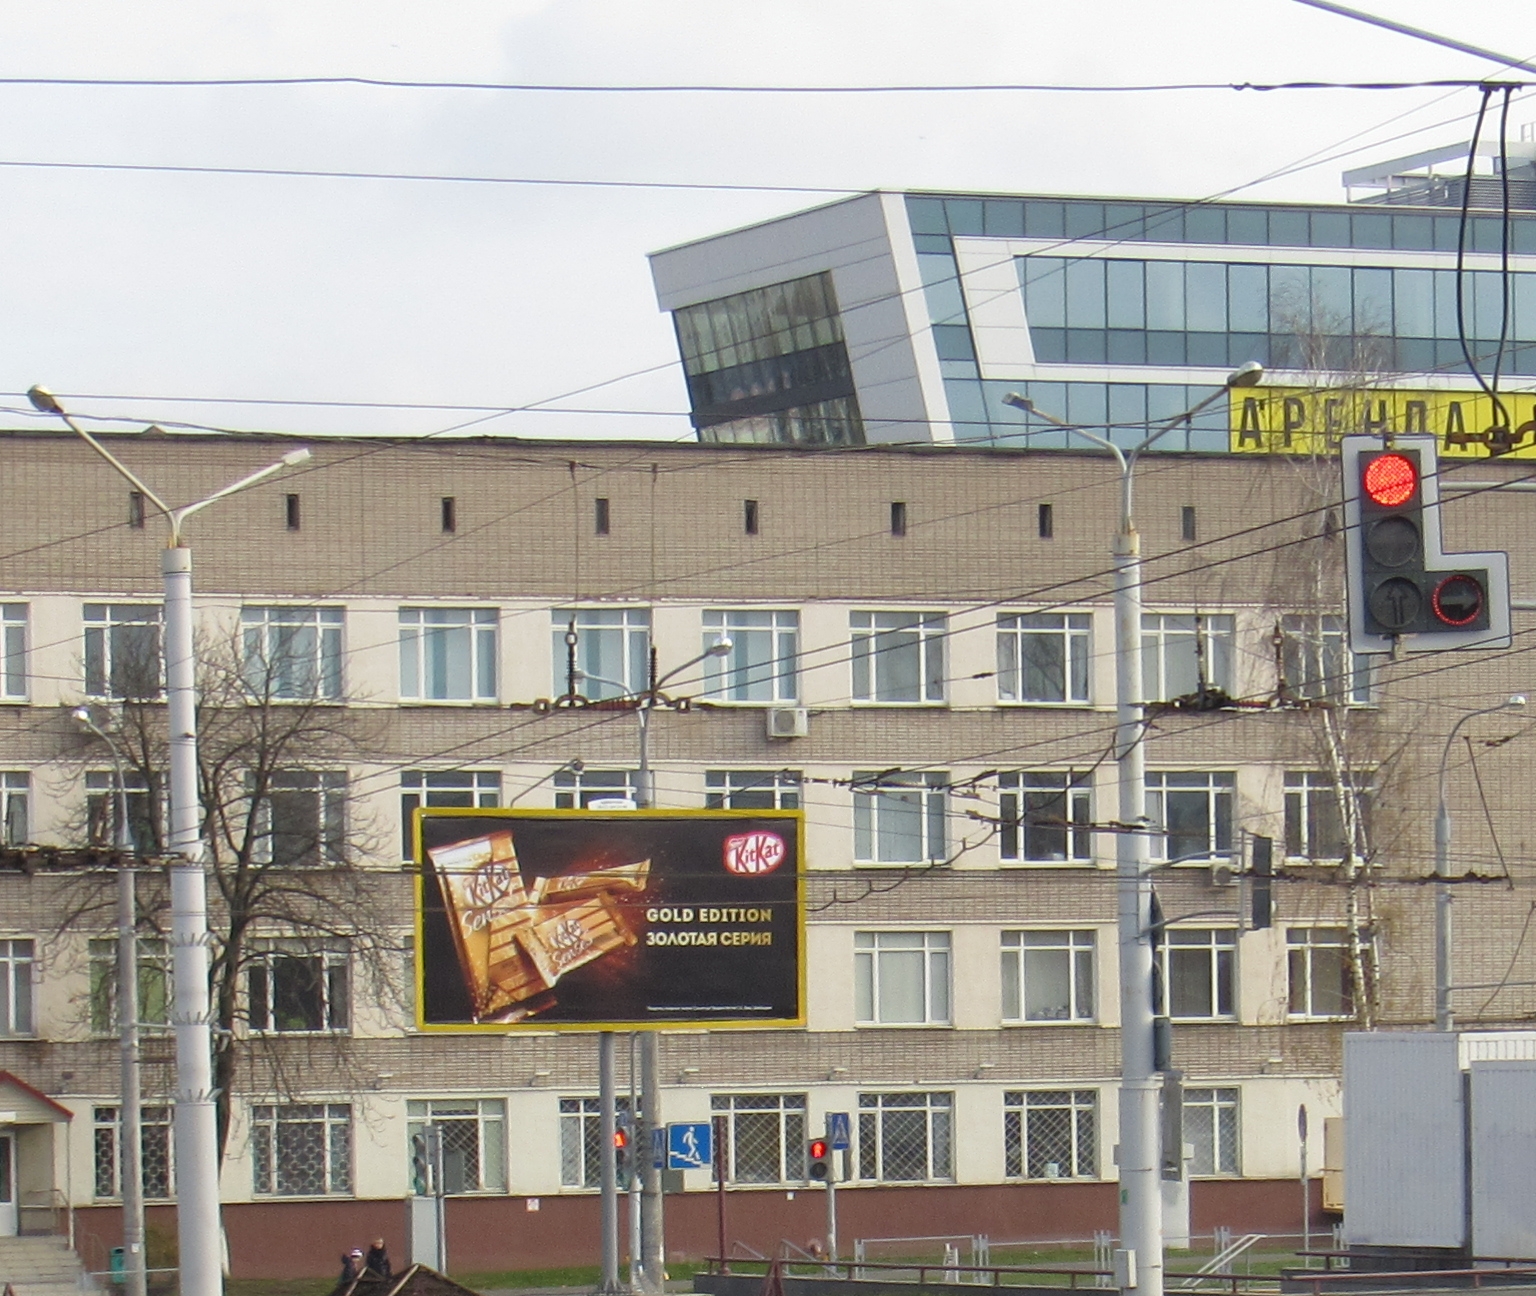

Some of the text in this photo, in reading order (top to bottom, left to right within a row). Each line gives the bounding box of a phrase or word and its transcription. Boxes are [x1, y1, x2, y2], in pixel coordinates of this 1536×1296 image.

[1238, 396, 1468, 452] АРЕНДА
[736, 835, 780, 873] KitKat
[646, 908, 772, 922] GOLD EDITION
[646, 931, 772, 946] ЗОЛОТАЯ СЕРИЯ
